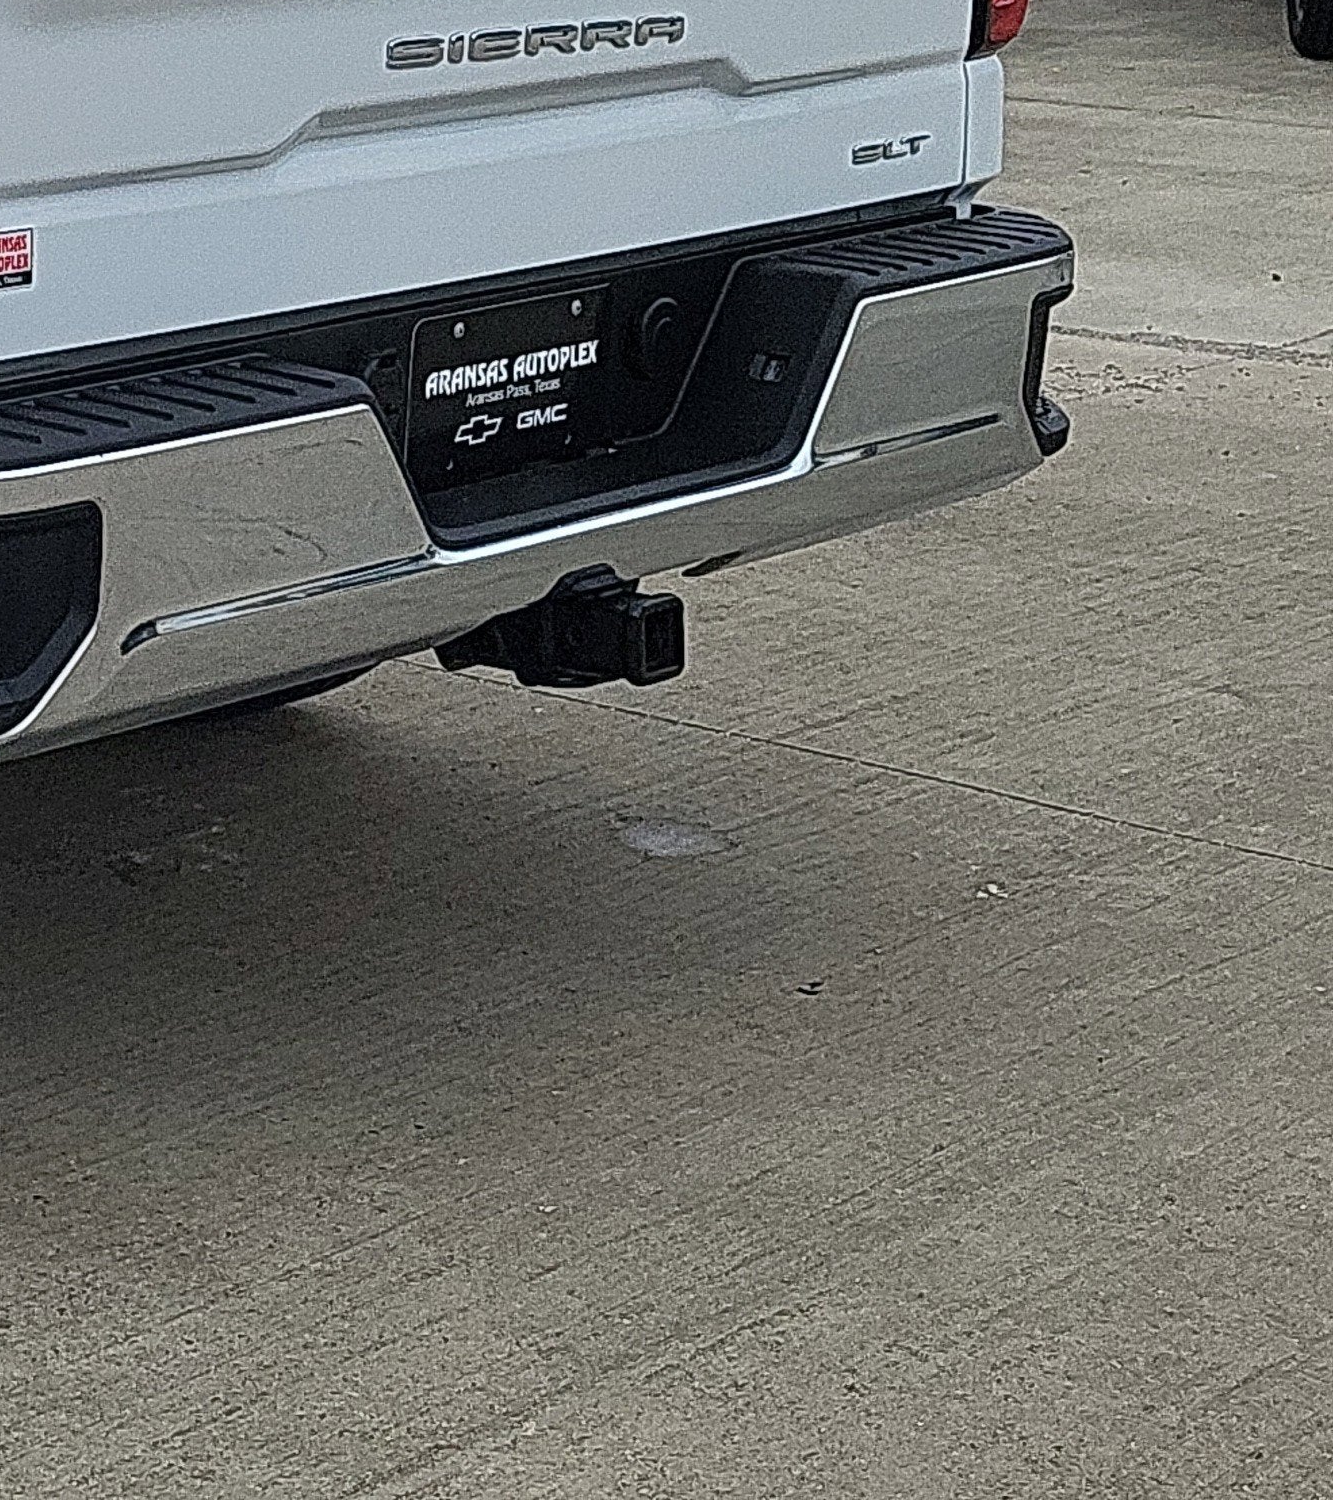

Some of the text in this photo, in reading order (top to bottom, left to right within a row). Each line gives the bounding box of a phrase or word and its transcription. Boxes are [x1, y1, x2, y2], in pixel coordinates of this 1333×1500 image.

[385, 15, 685, 70] SIERRA
[851, 134, 932, 165] SLT
[424, 339, 600, 400] ARANSAS AUTOPLEX
[516, 402, 569, 430] GMC
